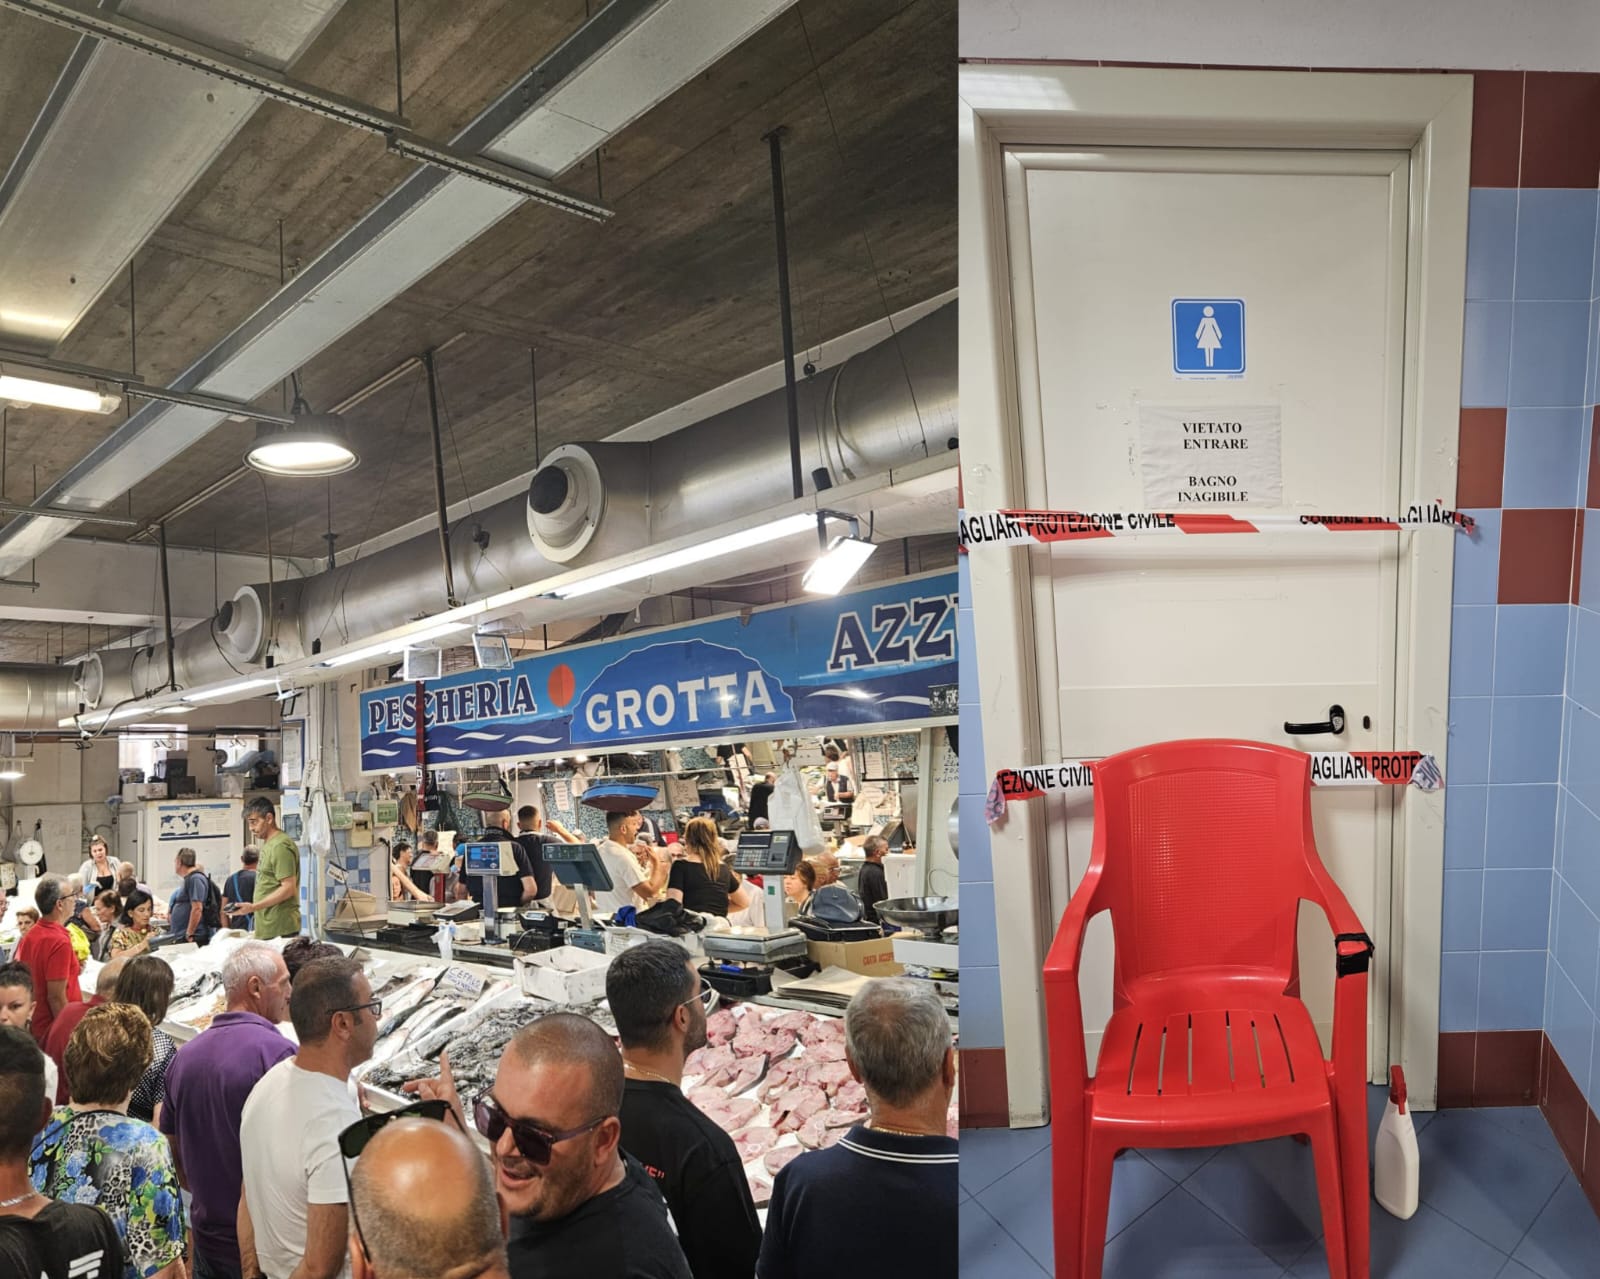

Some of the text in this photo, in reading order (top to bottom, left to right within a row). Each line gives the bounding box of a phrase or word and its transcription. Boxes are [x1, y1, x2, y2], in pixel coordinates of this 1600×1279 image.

[1182, 422, 1242, 434] VIETATO
[1183, 438, 1249, 450] ENTRARE
[1188, 475, 1237, 487] BAGNO
[1178, 491, 1248, 502] INAGIBILE
[959, 512, 1175, 545] AGLIARI PROTEZIONE CIVILE
[367, 592, 958, 735] PESCHERIA GROTTA AZZ
[1371, 755, 1424, 778] PROTE
[997, 769, 1055, 794] EZIONE
